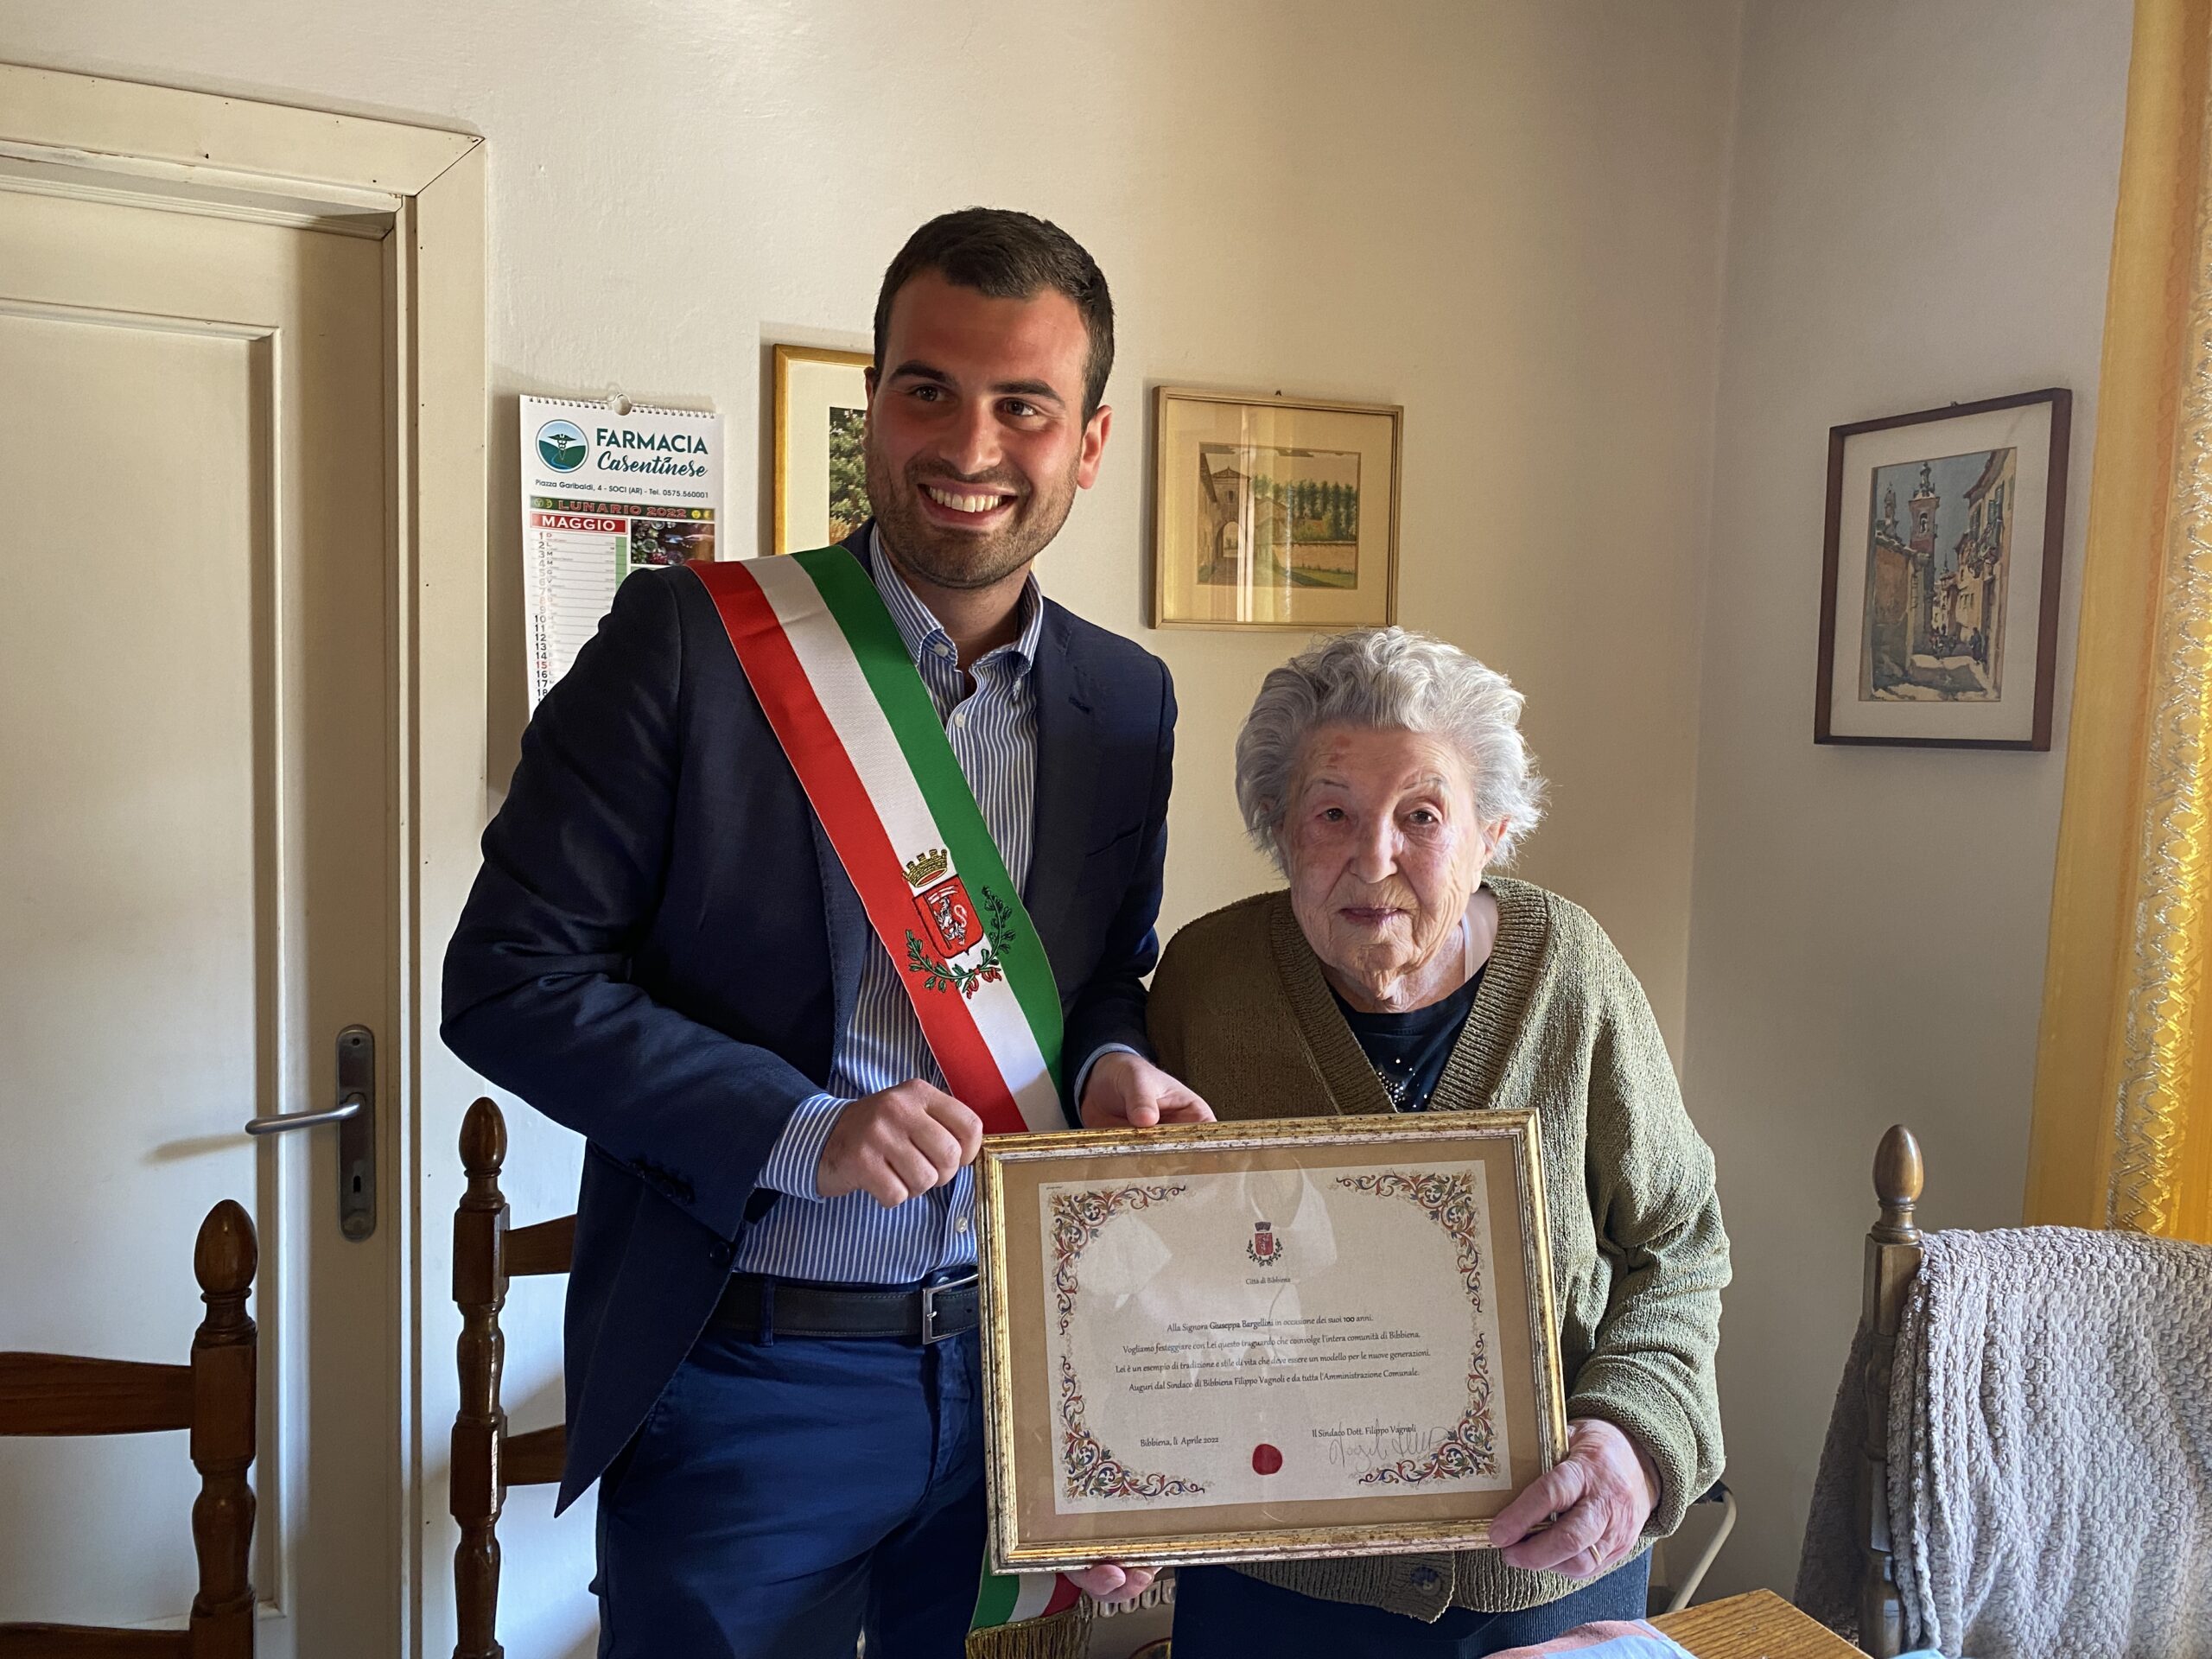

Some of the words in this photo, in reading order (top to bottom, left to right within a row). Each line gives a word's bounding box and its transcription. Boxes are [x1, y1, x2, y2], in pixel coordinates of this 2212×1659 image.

[596, 428, 709, 454] FARMACIA
[597, 450, 709, 477] Casentinese
[536, 479, 557, 487] Piazza
[559, 481, 595, 492] Garibaldi,
[628, 486, 643, 495] (AR)
[663, 489, 709, 499] 0575.560001
[558, 499, 641, 515] LUNARIO
[646, 506, 687, 518] 2022
[542, 516, 615, 531] MAGGIO
[535, 614, 546, 623] 10
[536, 624, 544, 632] 11
[537, 679, 548, 688] 17
[1167, 1322, 1181, 1332] Alla
[1182, 1323, 1208, 1333] Signora
[1210, 1321, 1241, 1331] Giuseppa
[1242, 1319, 1273, 1330] Bargellini
[1316, 1315, 1326, 1324] dei
[1122, 1344, 1154, 1356] Vogliamo
[1154, 1343, 1192, 1354] festeggiare
[1218, 1341, 1240, 1351] questo
[1242, 1336, 1275, 1349] traguardo
[1289, 1335, 1320, 1345] coinvolge
[1347, 1332, 1379, 1341] comunità
[1380, 1331, 1388, 1339] di
[1143, 1363, 1171, 1374] esempio
[1172, 1362, 1179, 1370] di
[1221, 1358, 1234, 1367] stile
[1236, 1357, 1243, 1366] di
[1258, 1357, 1270, 1365] che
[1271, 1356, 1287, 1365] deve
[1319, 1352, 1347, 1362] modello
[1348, 1354, 1360, 1363] per
[1361, 1351, 1367, 1360] le
[1128, 1383, 1154, 1394] Auguri
[1154, 1382, 1166, 1390] dal
[1166, 1380, 1192, 1389] Sindaco
[1194, 1379, 1202, 1388] di
[1203, 1378, 1233, 1387] Bibbiena
[1234, 1376, 1258, 1387] Filippo
[1259, 1375, 1285, 1386] Vagnoli
[1292, 1373, 1300, 1382] da
[1319, 1371, 1382, 1381] l'Amministrazione
[1382, 1367, 1420, 1377] Comunale.
[1312, 1428, 1318, 1438] Il
[1318, 1428, 1345, 1438] Sindaco
[1346, 1427, 1363, 1436] Dott.
[1365, 1426, 1389, 1437] Filippo
[1389, 1423, 1416, 1434] Vagnoli
[1140, 1438, 1172, 1447] Bibbiena,
[1180, 1435, 1202, 1446] Aprile
